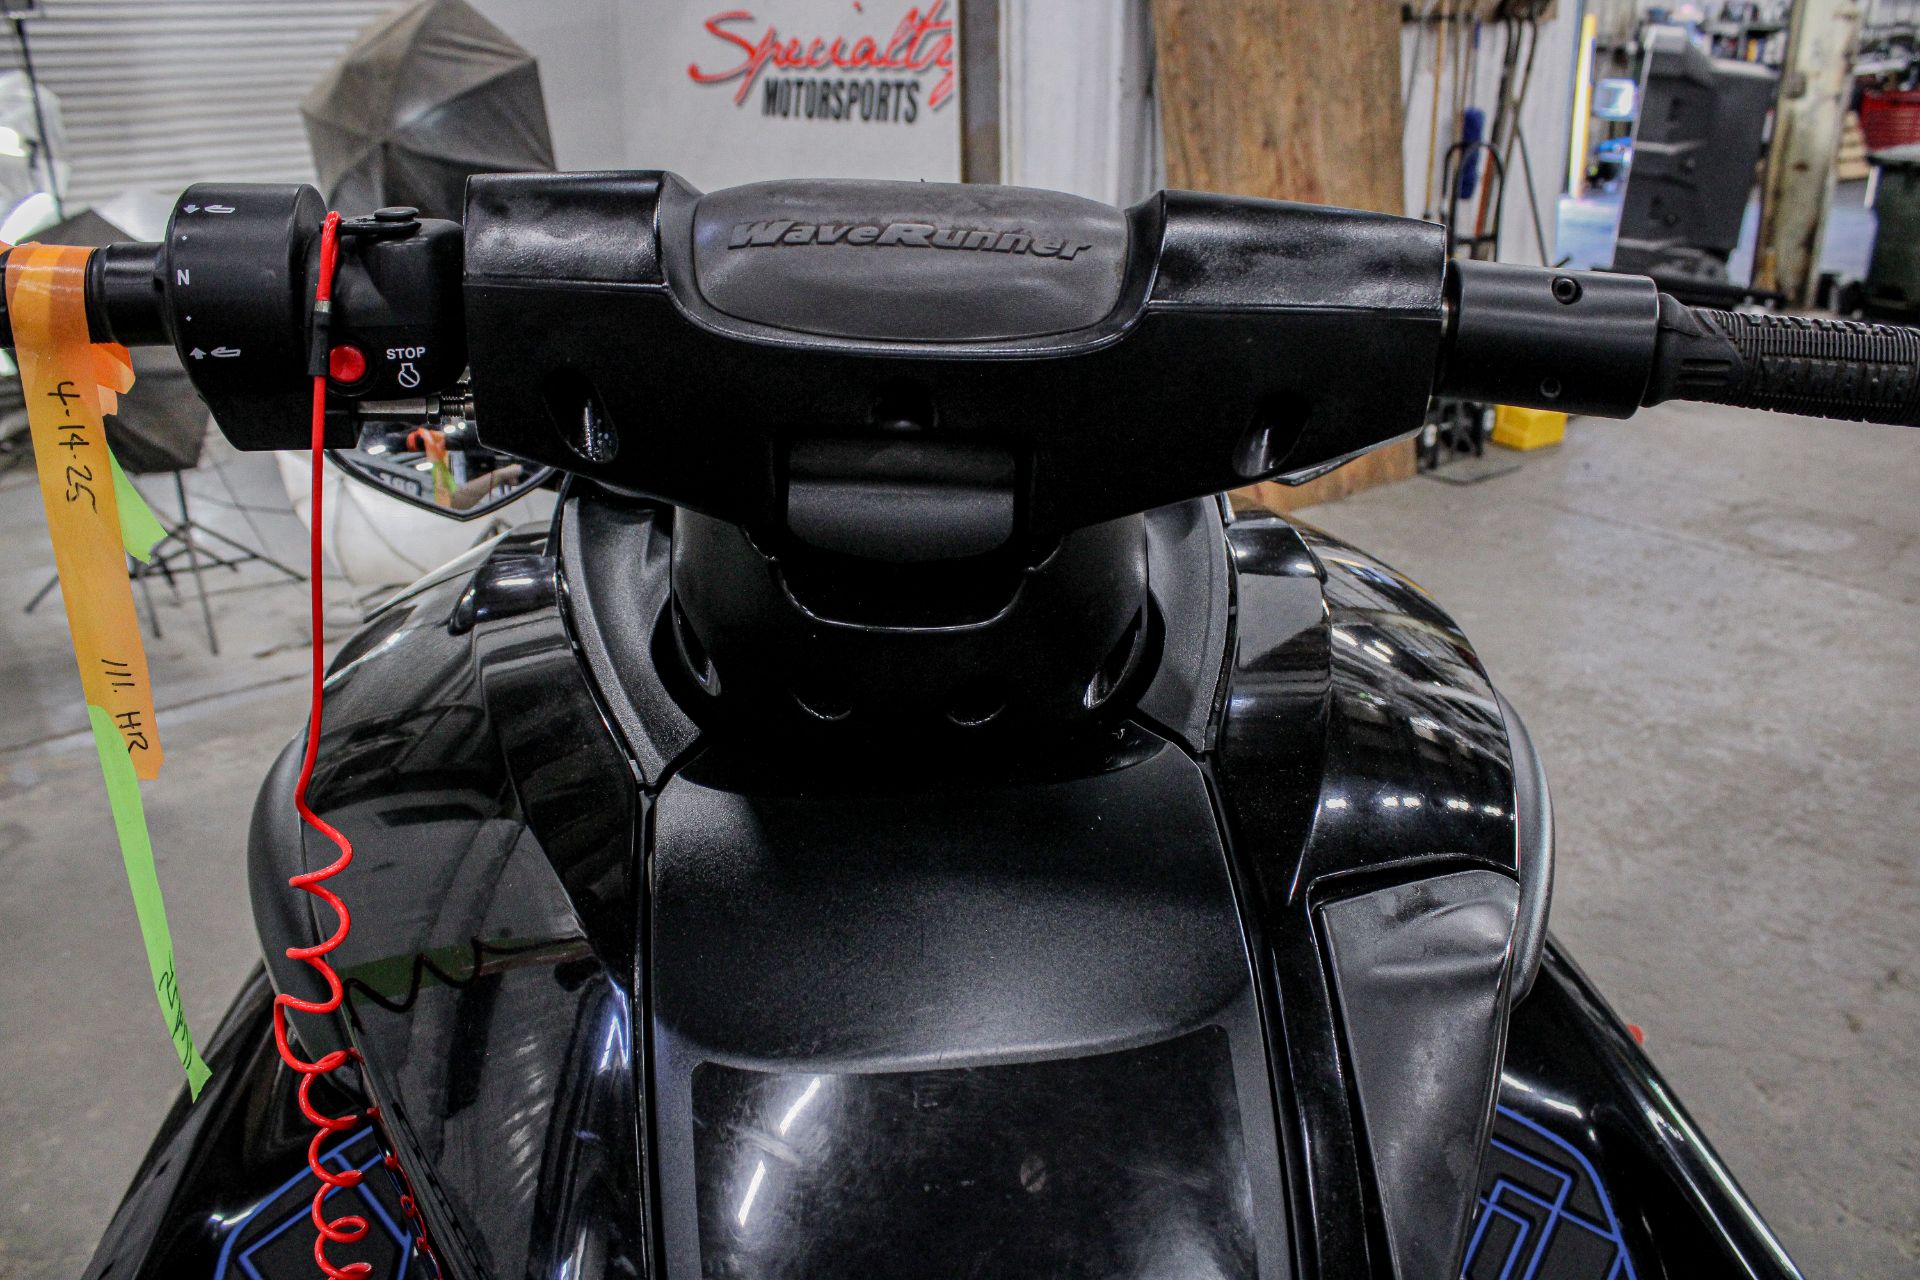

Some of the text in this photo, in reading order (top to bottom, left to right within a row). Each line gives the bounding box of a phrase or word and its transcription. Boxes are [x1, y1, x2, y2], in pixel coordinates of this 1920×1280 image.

[762, 77, 920, 123] MOTORSPORTS
[728, 219, 1092, 260] WaveRunner
[177, 269, 190, 286] N
[386, 347, 426, 360] STOP
[115, 711, 148, 754] HR
